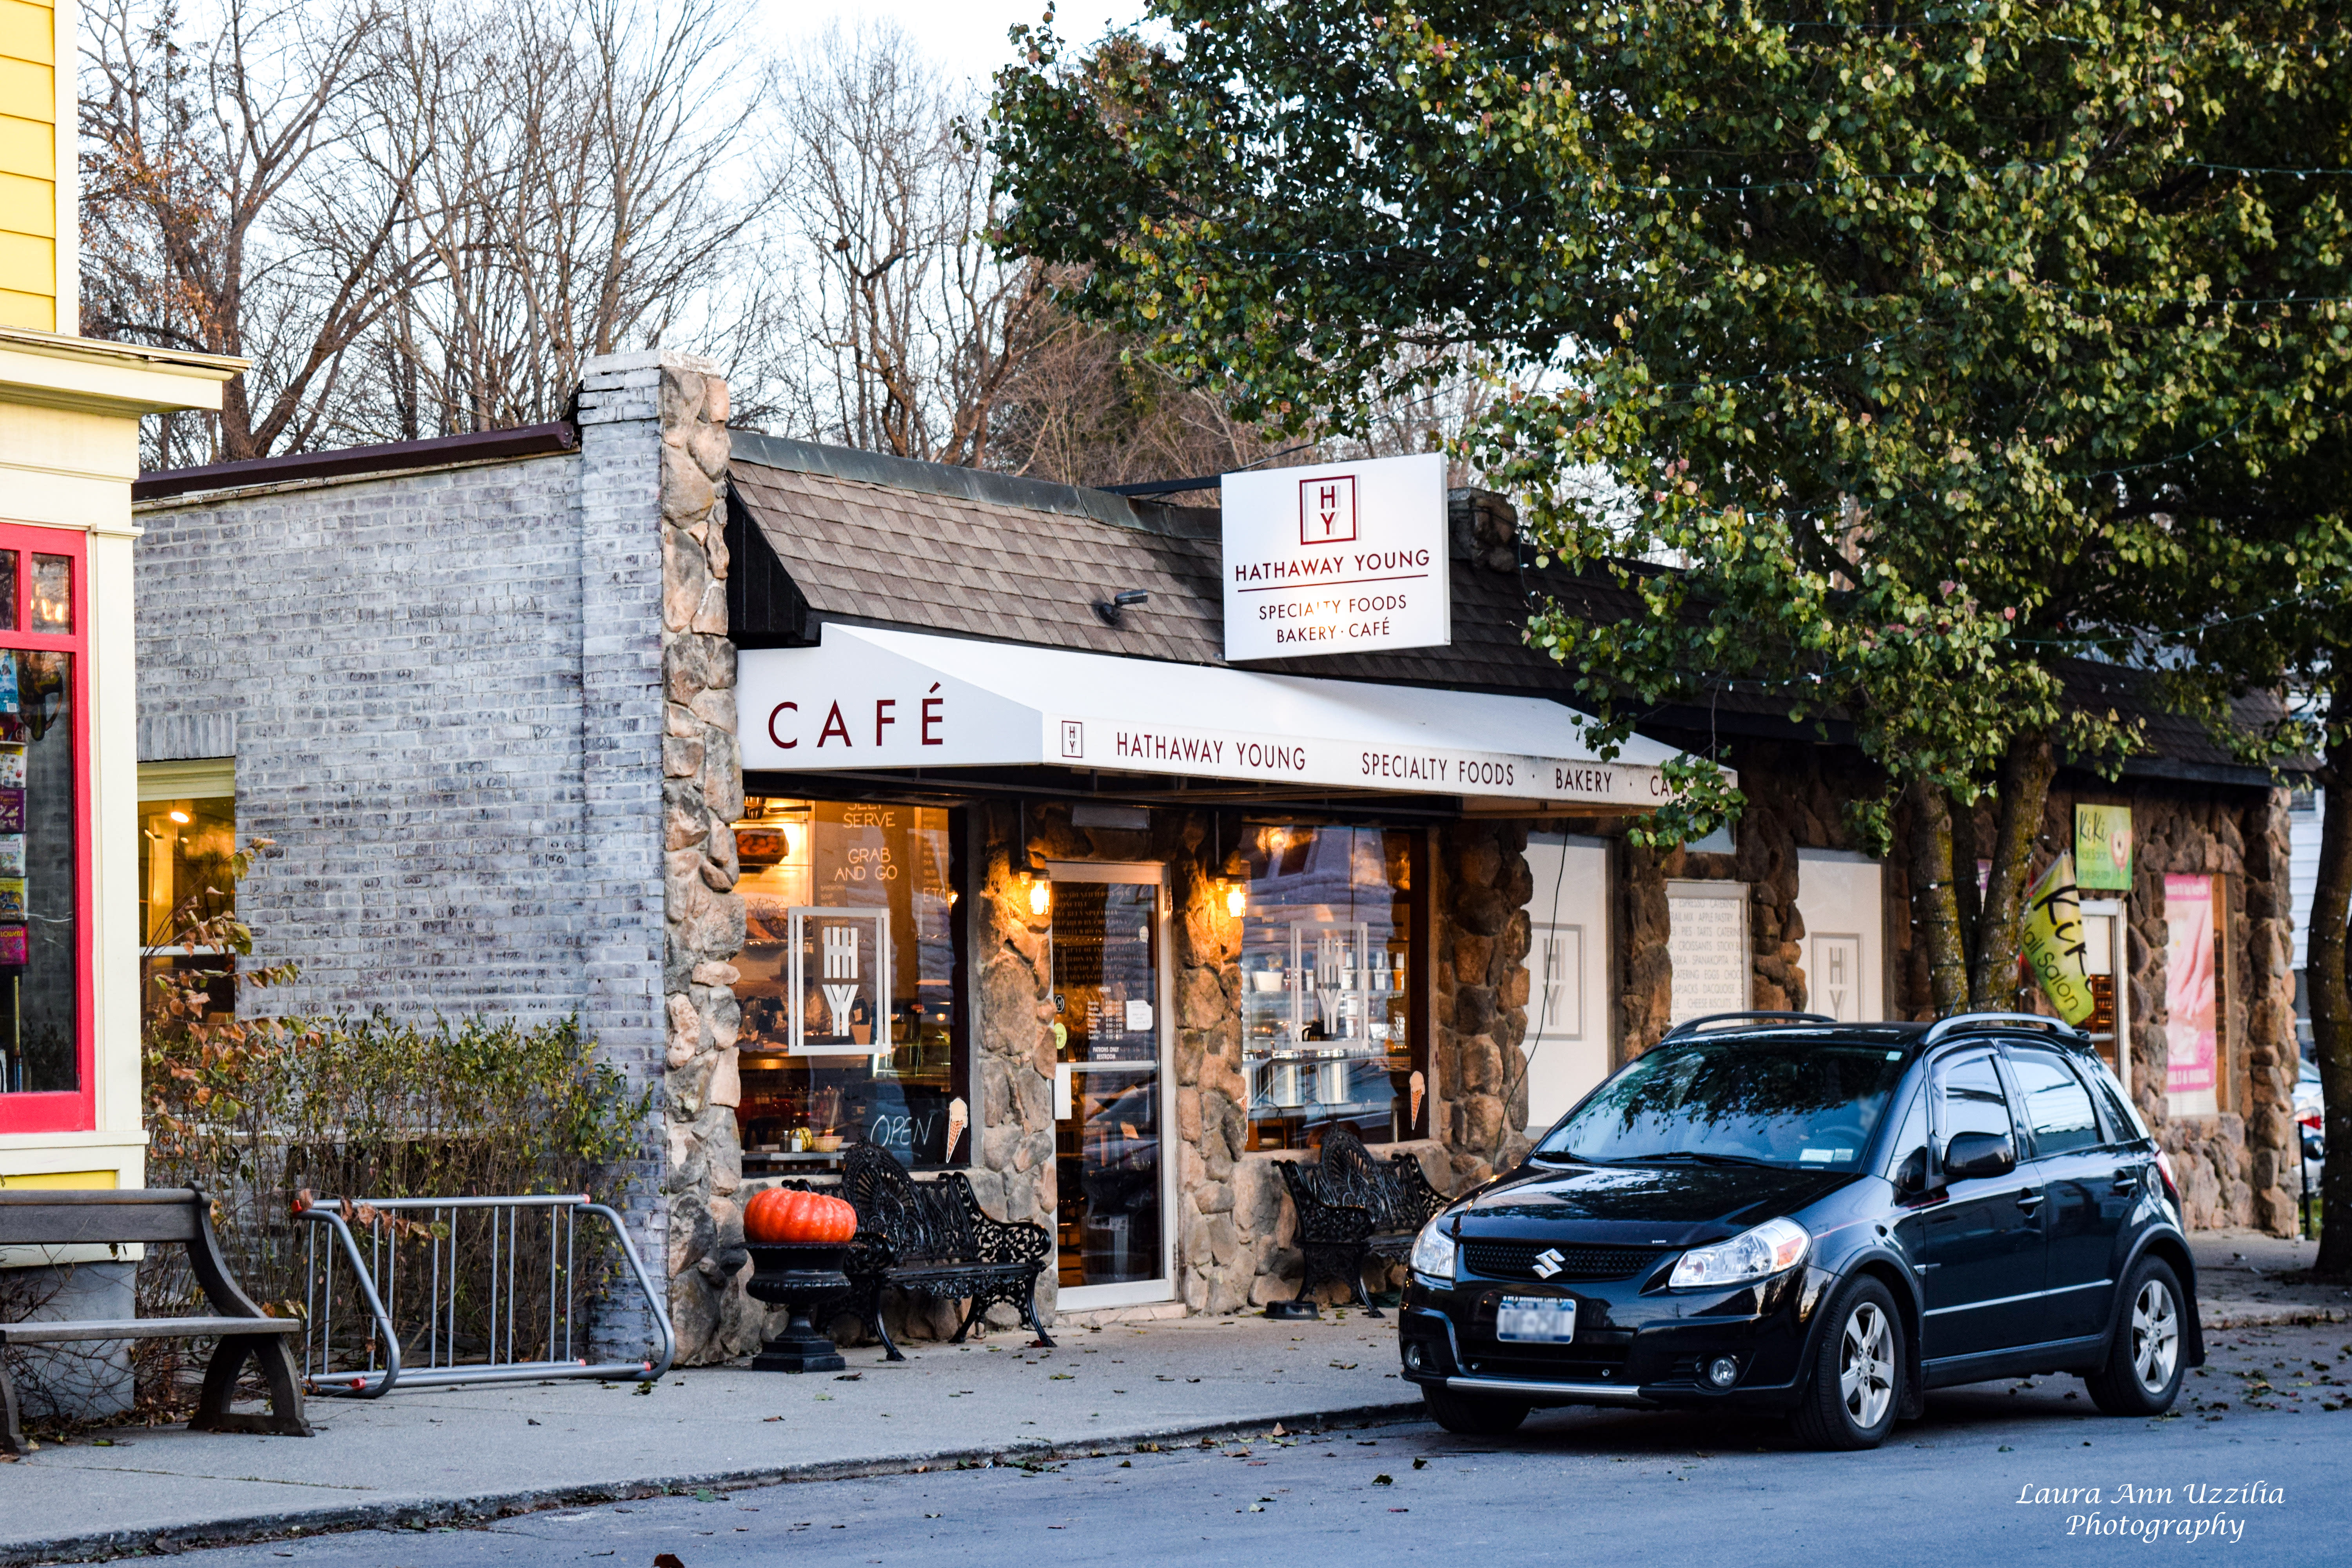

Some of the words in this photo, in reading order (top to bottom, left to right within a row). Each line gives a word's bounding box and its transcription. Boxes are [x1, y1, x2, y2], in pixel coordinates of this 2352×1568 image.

[1320, 485, 1335, 509] H
[1320, 512, 1335, 535] Y
[1235, 556, 1344, 582] HATHAWAY
[1355, 549, 1430, 571] YOUNG
[1349, 595, 1406, 613] FOODS
[1277, 625, 1336, 643] BAKERY
[1349, 617, 1390, 638] CAFÉ
[768, 682, 944, 749] CAFÉ
[1117, 731, 1223, 764] HATHAWAY
[1236, 742, 1305, 770] YOUNG
[1362, 752, 1447, 781] SPECIALTY
[1459, 761, 1514, 786] FOODS
[1556, 768, 1612, 793] BAKERY
[1650, 775, 1687, 797] CA
[843, 811, 896, 829] SERVE
[848, 847, 891, 864] GRAB
[834, 866, 866, 882] AND
[875, 864, 898, 881] GO
[1671, 912, 1682, 922] RAIL
[1717, 927, 1741, 937] CATERIN
[822, 984, 859, 1036] Y
[870, 1114, 934, 1147] OPEN
